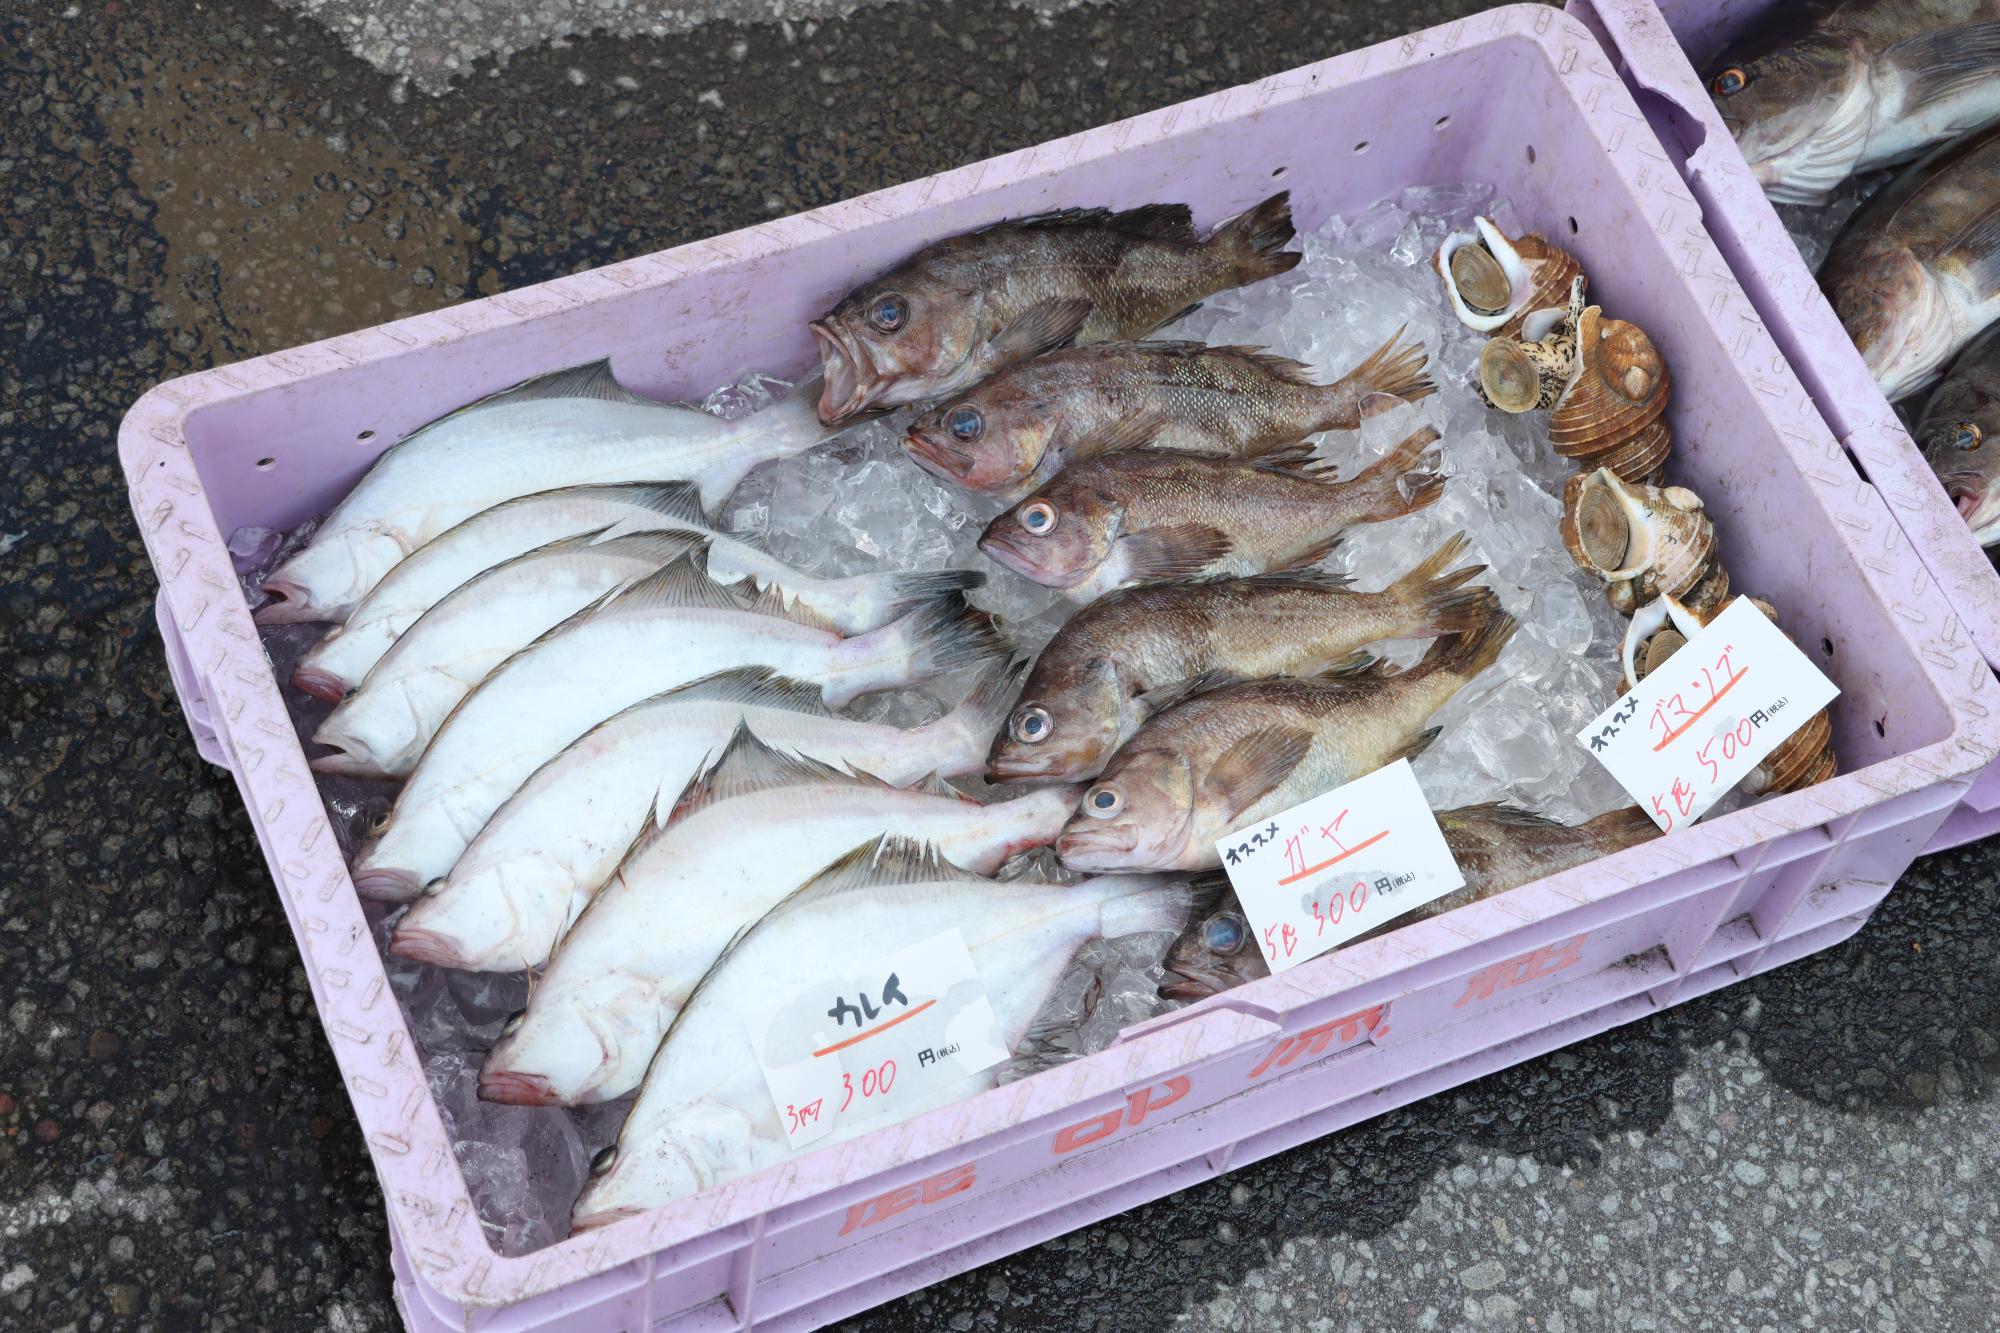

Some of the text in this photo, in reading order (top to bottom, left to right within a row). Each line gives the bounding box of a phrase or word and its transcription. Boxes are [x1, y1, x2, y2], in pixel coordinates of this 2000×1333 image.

[1591, 696, 1639, 752] オススメ
[1226, 822, 1280, 865] オススメ
[1284, 808, 1349, 878] ガヤ
[827, 972, 908, 1028] カレイ
